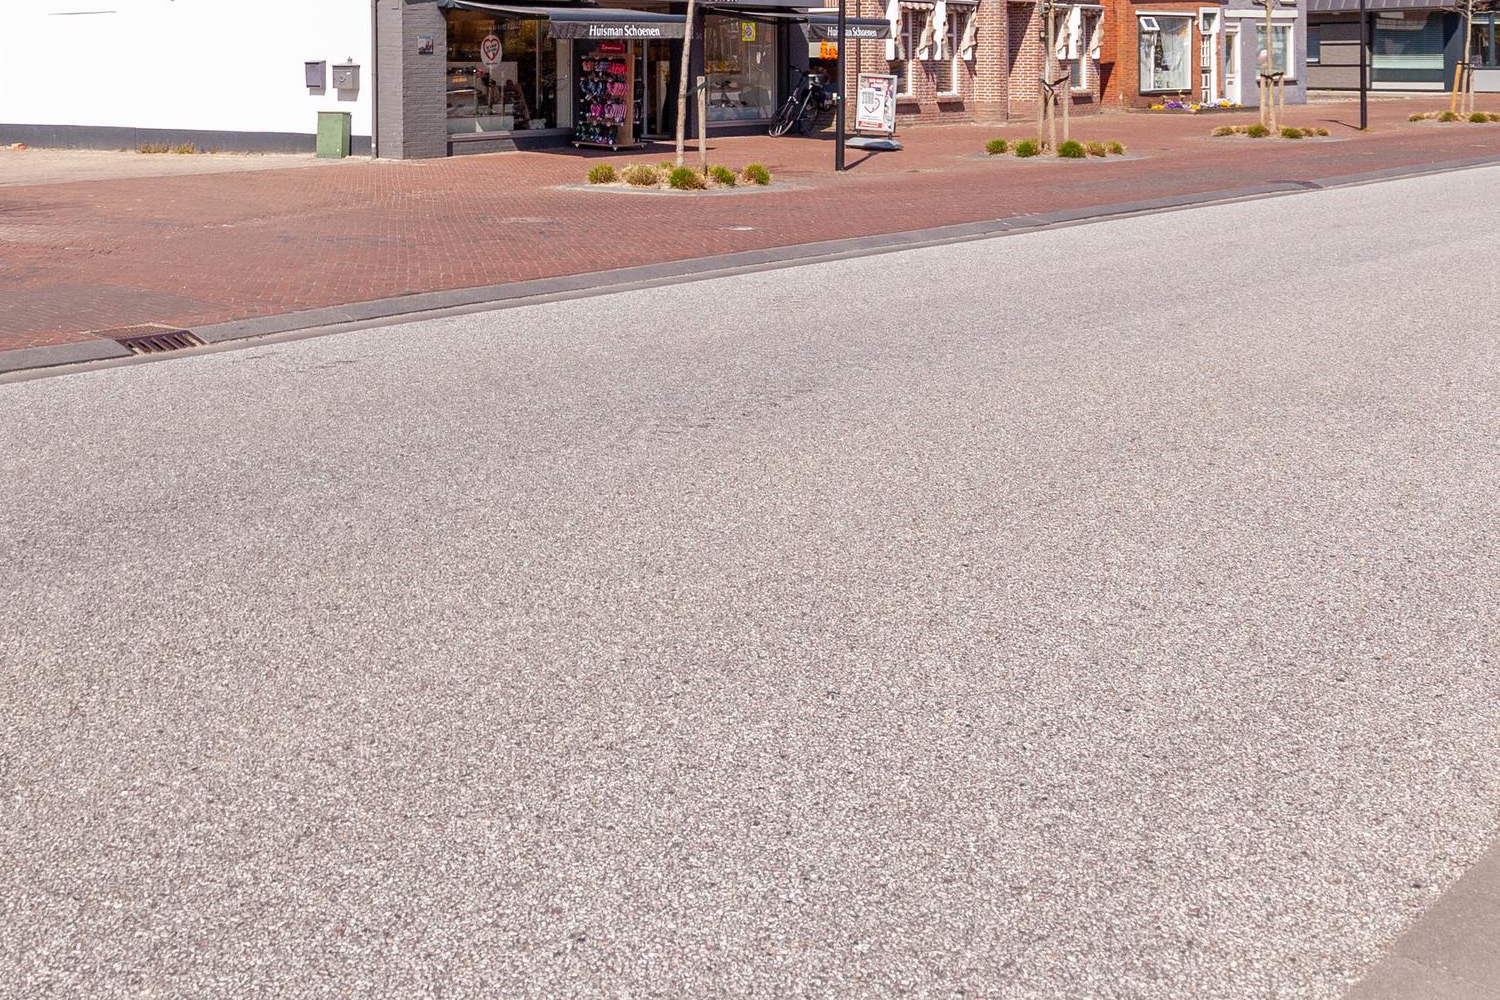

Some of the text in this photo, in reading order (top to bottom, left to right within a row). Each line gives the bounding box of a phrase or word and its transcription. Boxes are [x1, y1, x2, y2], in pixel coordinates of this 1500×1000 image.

[589, 24, 660, 36] Huisman Schoenen
[827, 26, 877, 37] Huian Schoenen
